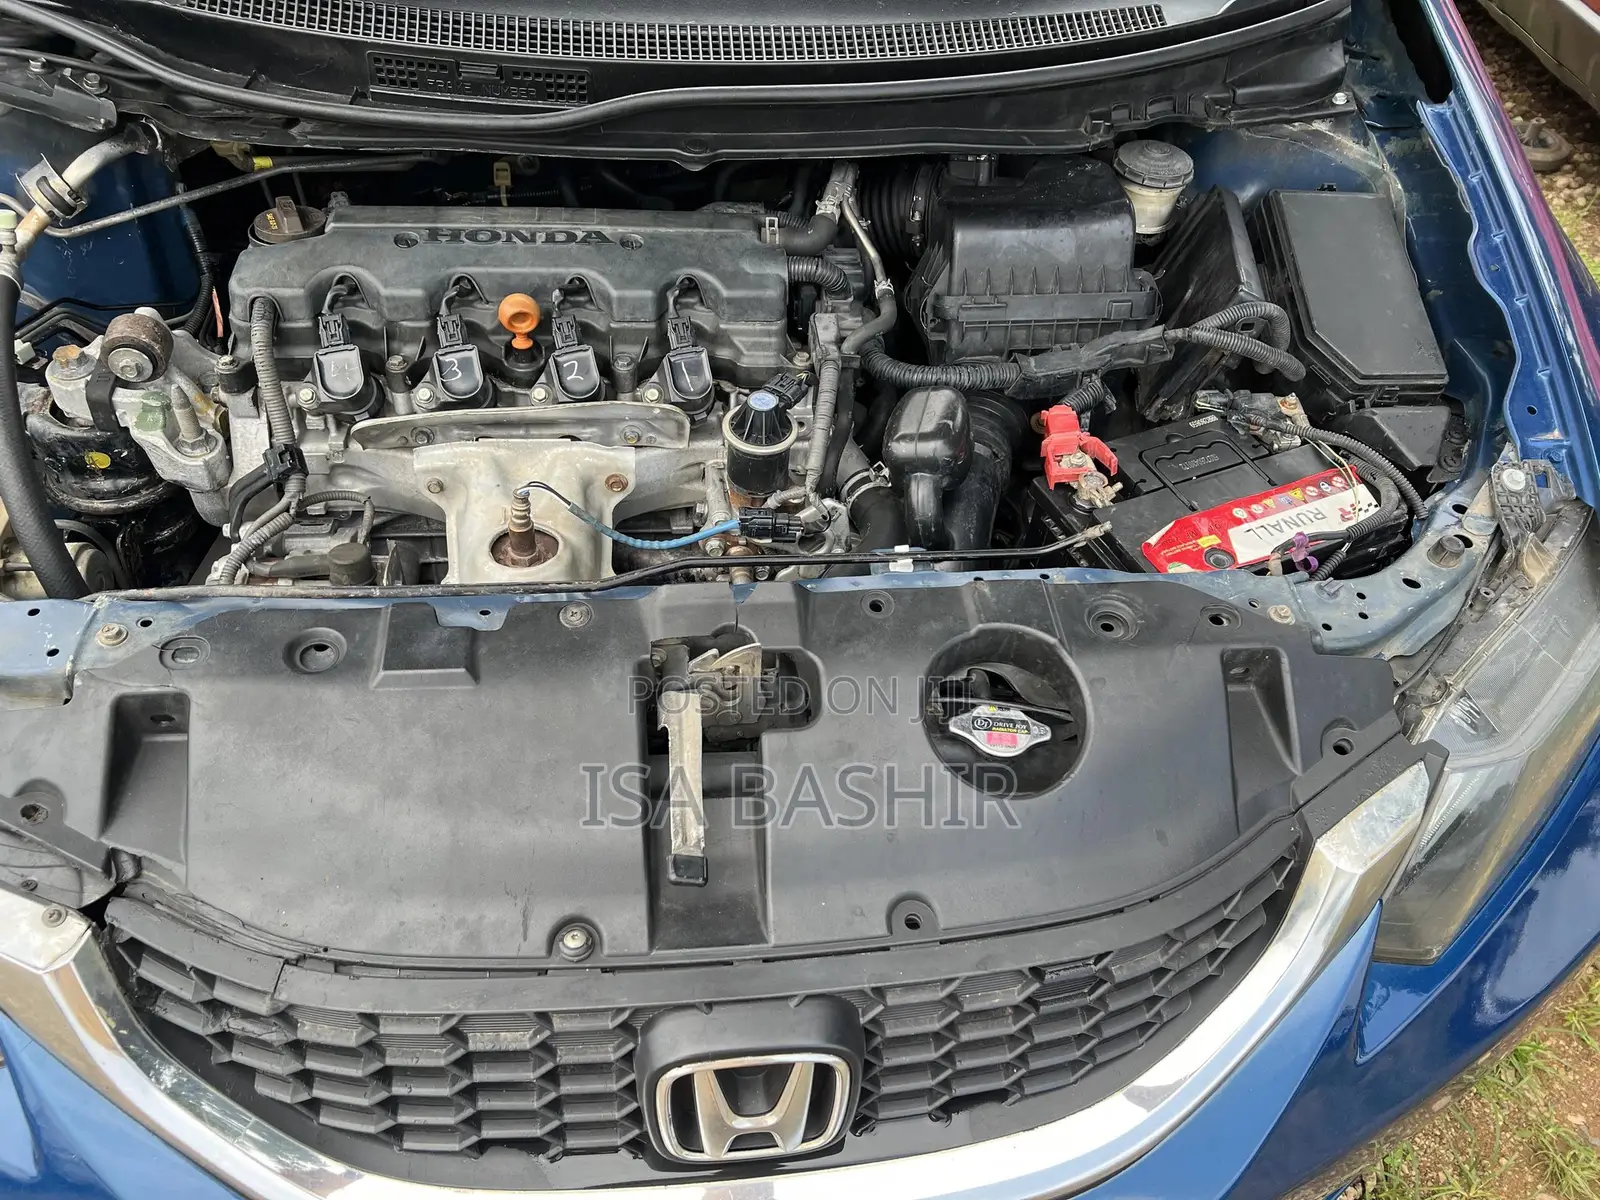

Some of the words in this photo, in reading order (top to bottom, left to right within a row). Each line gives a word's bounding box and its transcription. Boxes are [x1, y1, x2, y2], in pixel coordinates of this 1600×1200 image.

[426, 78, 472, 94] FRAME
[482, 84, 537, 99] NUMBER
[422, 228, 618, 245] HONDA
[440, 358, 462, 382] 3
[563, 360, 584, 381] 2
[681, 361, 694, 392] 1
[1244, 507, 1328, 540] RUNALL
[993, 721, 1014, 729] DRIVE
[1015, 722, 1028, 730] JOY
